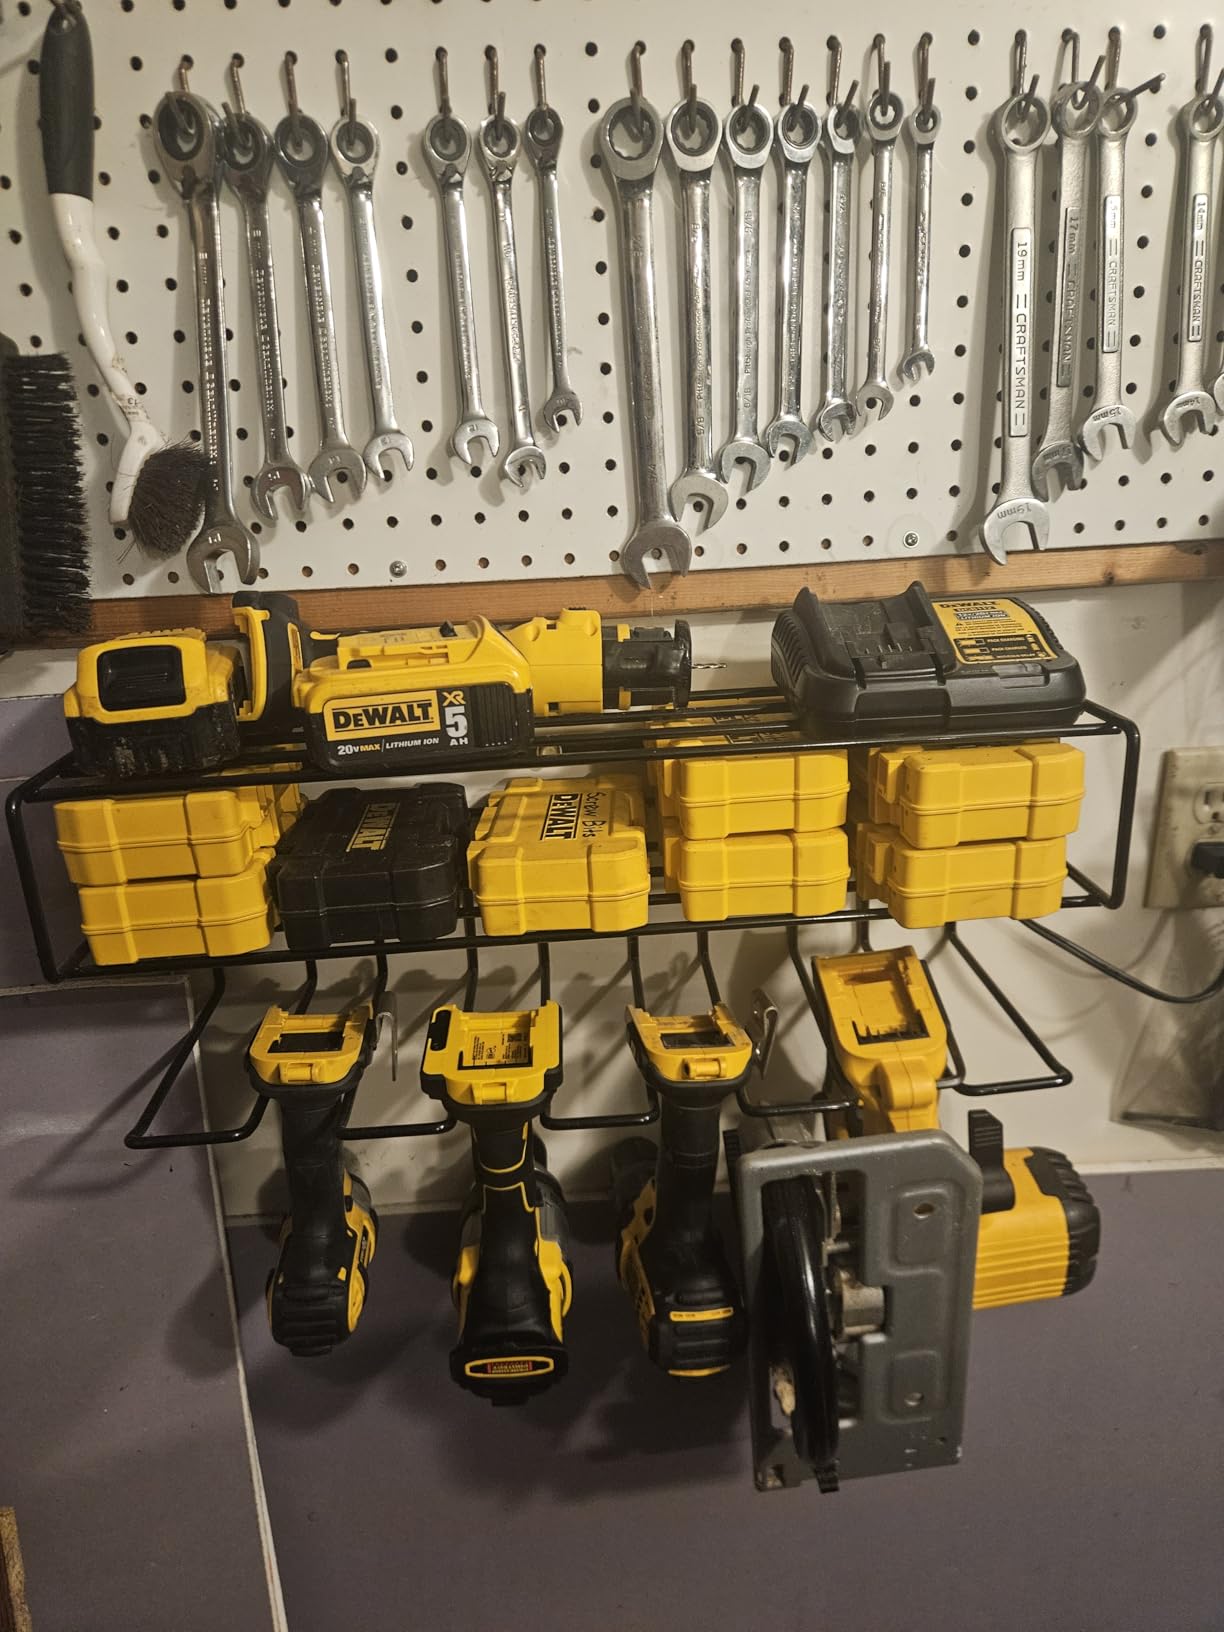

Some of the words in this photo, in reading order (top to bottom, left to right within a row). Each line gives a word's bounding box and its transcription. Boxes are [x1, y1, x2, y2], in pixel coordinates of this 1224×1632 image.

[1068, 216, 1079, 255] 17mm
[1016, 242, 1028, 282] 19mm
[1108, 260, 1118, 327] CRAFTSMAN
[1192, 260, 1203, 323] CRAFTSMAN
[1062, 280, 1076, 364] CRAFTSMAN
[1014, 313, 1027, 410] CRAFTSMAN
[1092, 406, 1122, 422] 15mm
[996, 502, 1033, 520] 19mm
[442, 690, 466, 706] XR
[445, 705, 468, 738] 5
[386, 739, 422, 749] LITHIUM
[423, 737, 439, 746] ION
[584, 792, 607, 817] Screw
[582, 820, 607, 838] Bits
